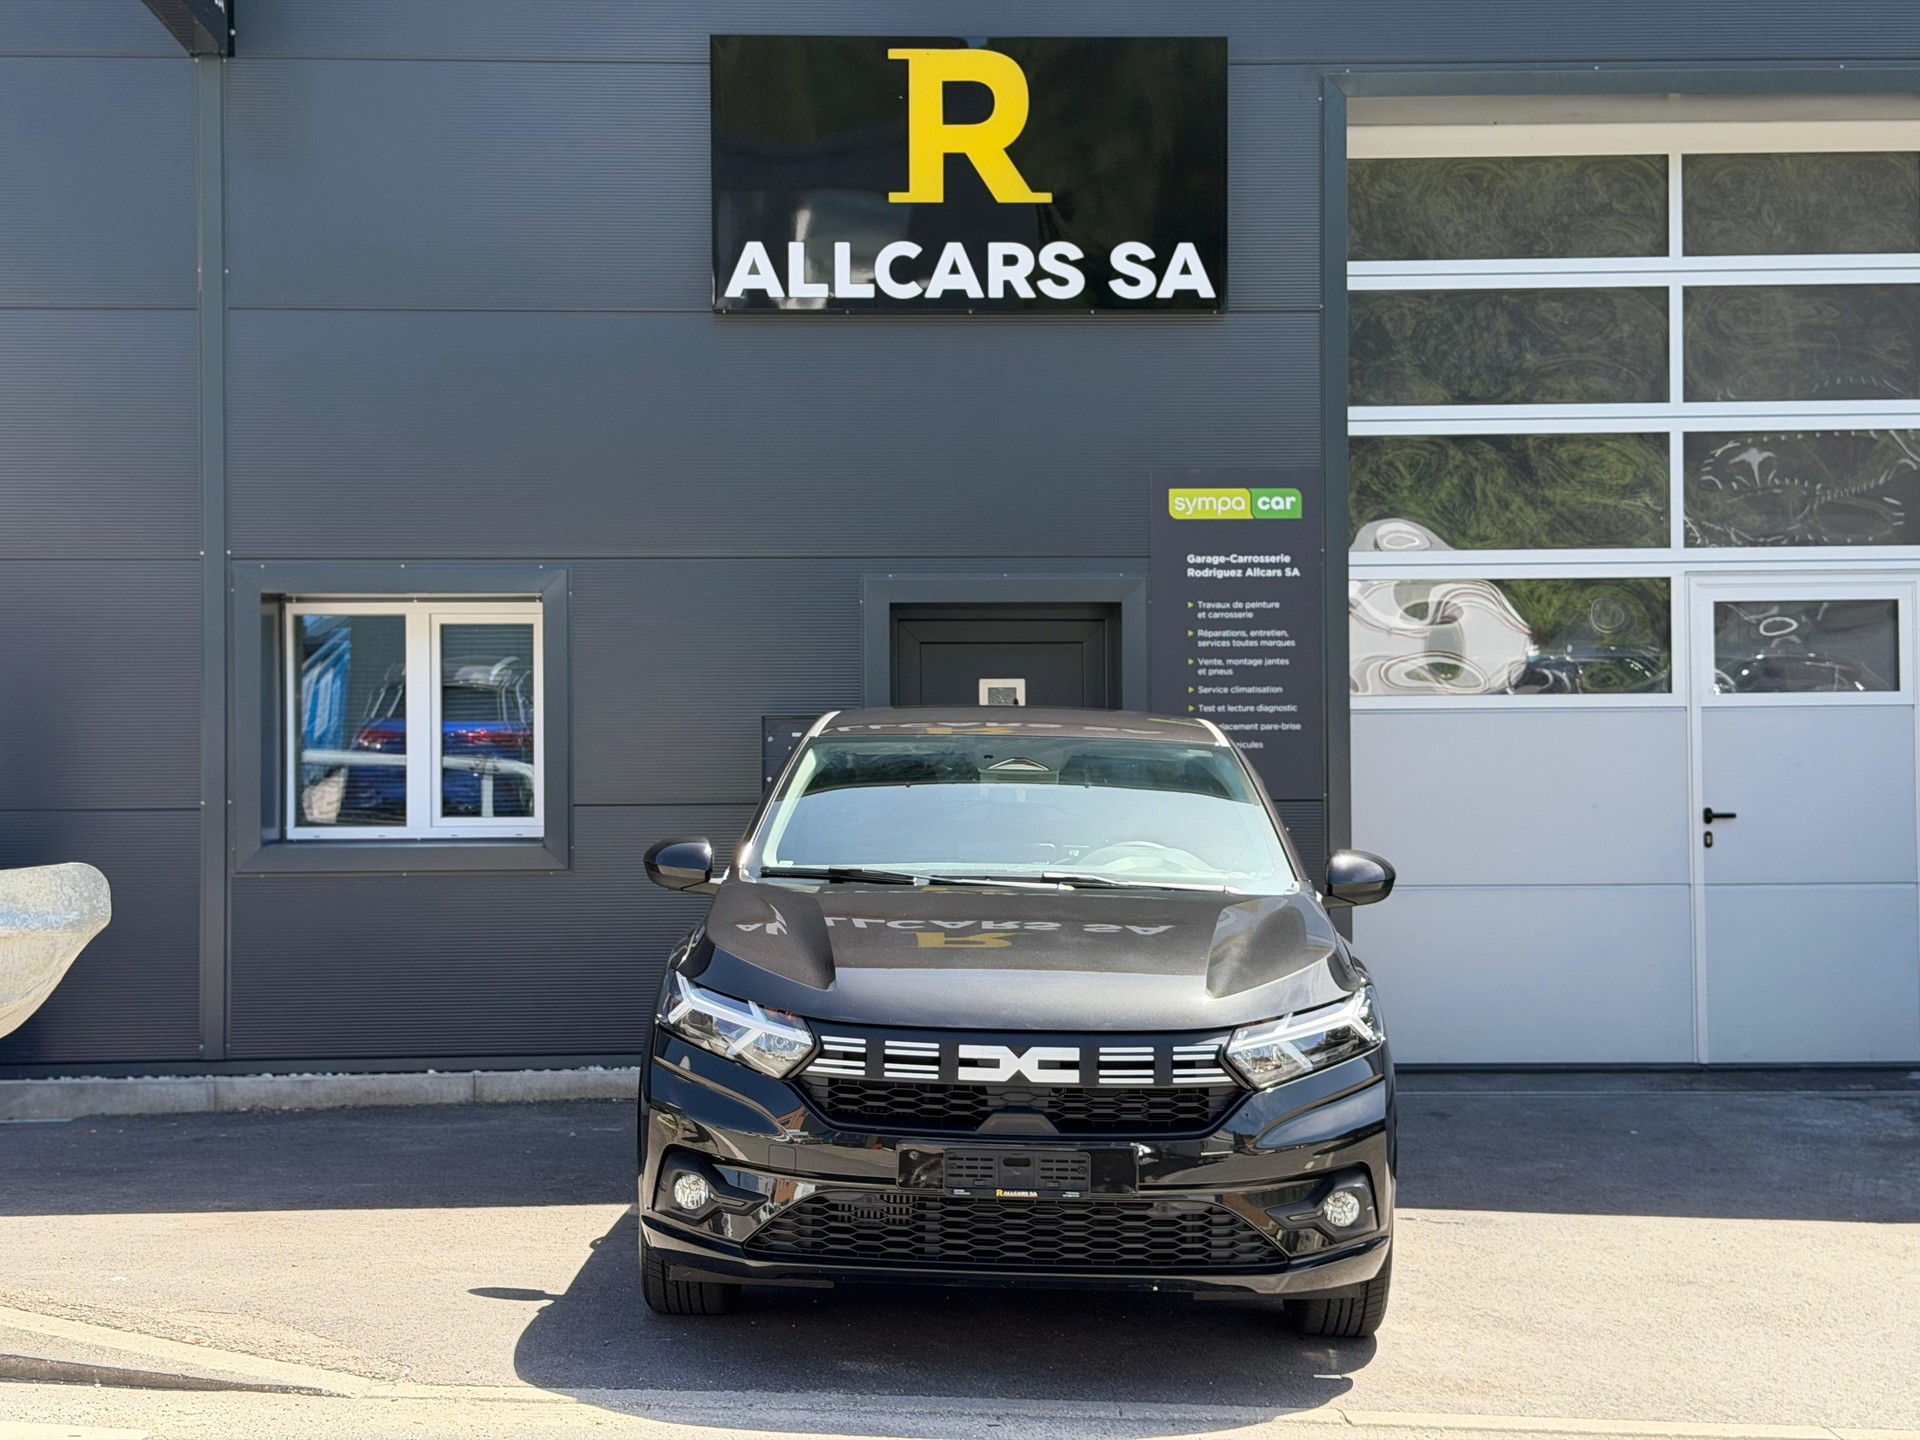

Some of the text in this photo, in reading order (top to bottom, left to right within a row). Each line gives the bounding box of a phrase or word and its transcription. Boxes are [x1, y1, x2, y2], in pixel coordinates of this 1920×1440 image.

[888, 48, 1053, 203] R
[724, 241, 1216, 299] ALLCARS SA
[1174, 496, 1296, 516] sympa car
[1187, 554, 1291, 565] Garage-Carrosserie
[1187, 567, 1301, 579] Rodriguez Allcars SA
[1197, 601, 1280, 611] Travaux de peinture
[1197, 629, 1289, 638] Réparations, entretien,
[1197, 639, 1295, 648] services toutes marques
[1198, 658, 1289, 667] Vente, montage jantes
[1198, 704, 1216, 712] Test
[1227, 704, 1254, 712] lecture
[1256, 704, 1297, 713] diagnostic
[1260, 723, 1301, 731] pare-brise
